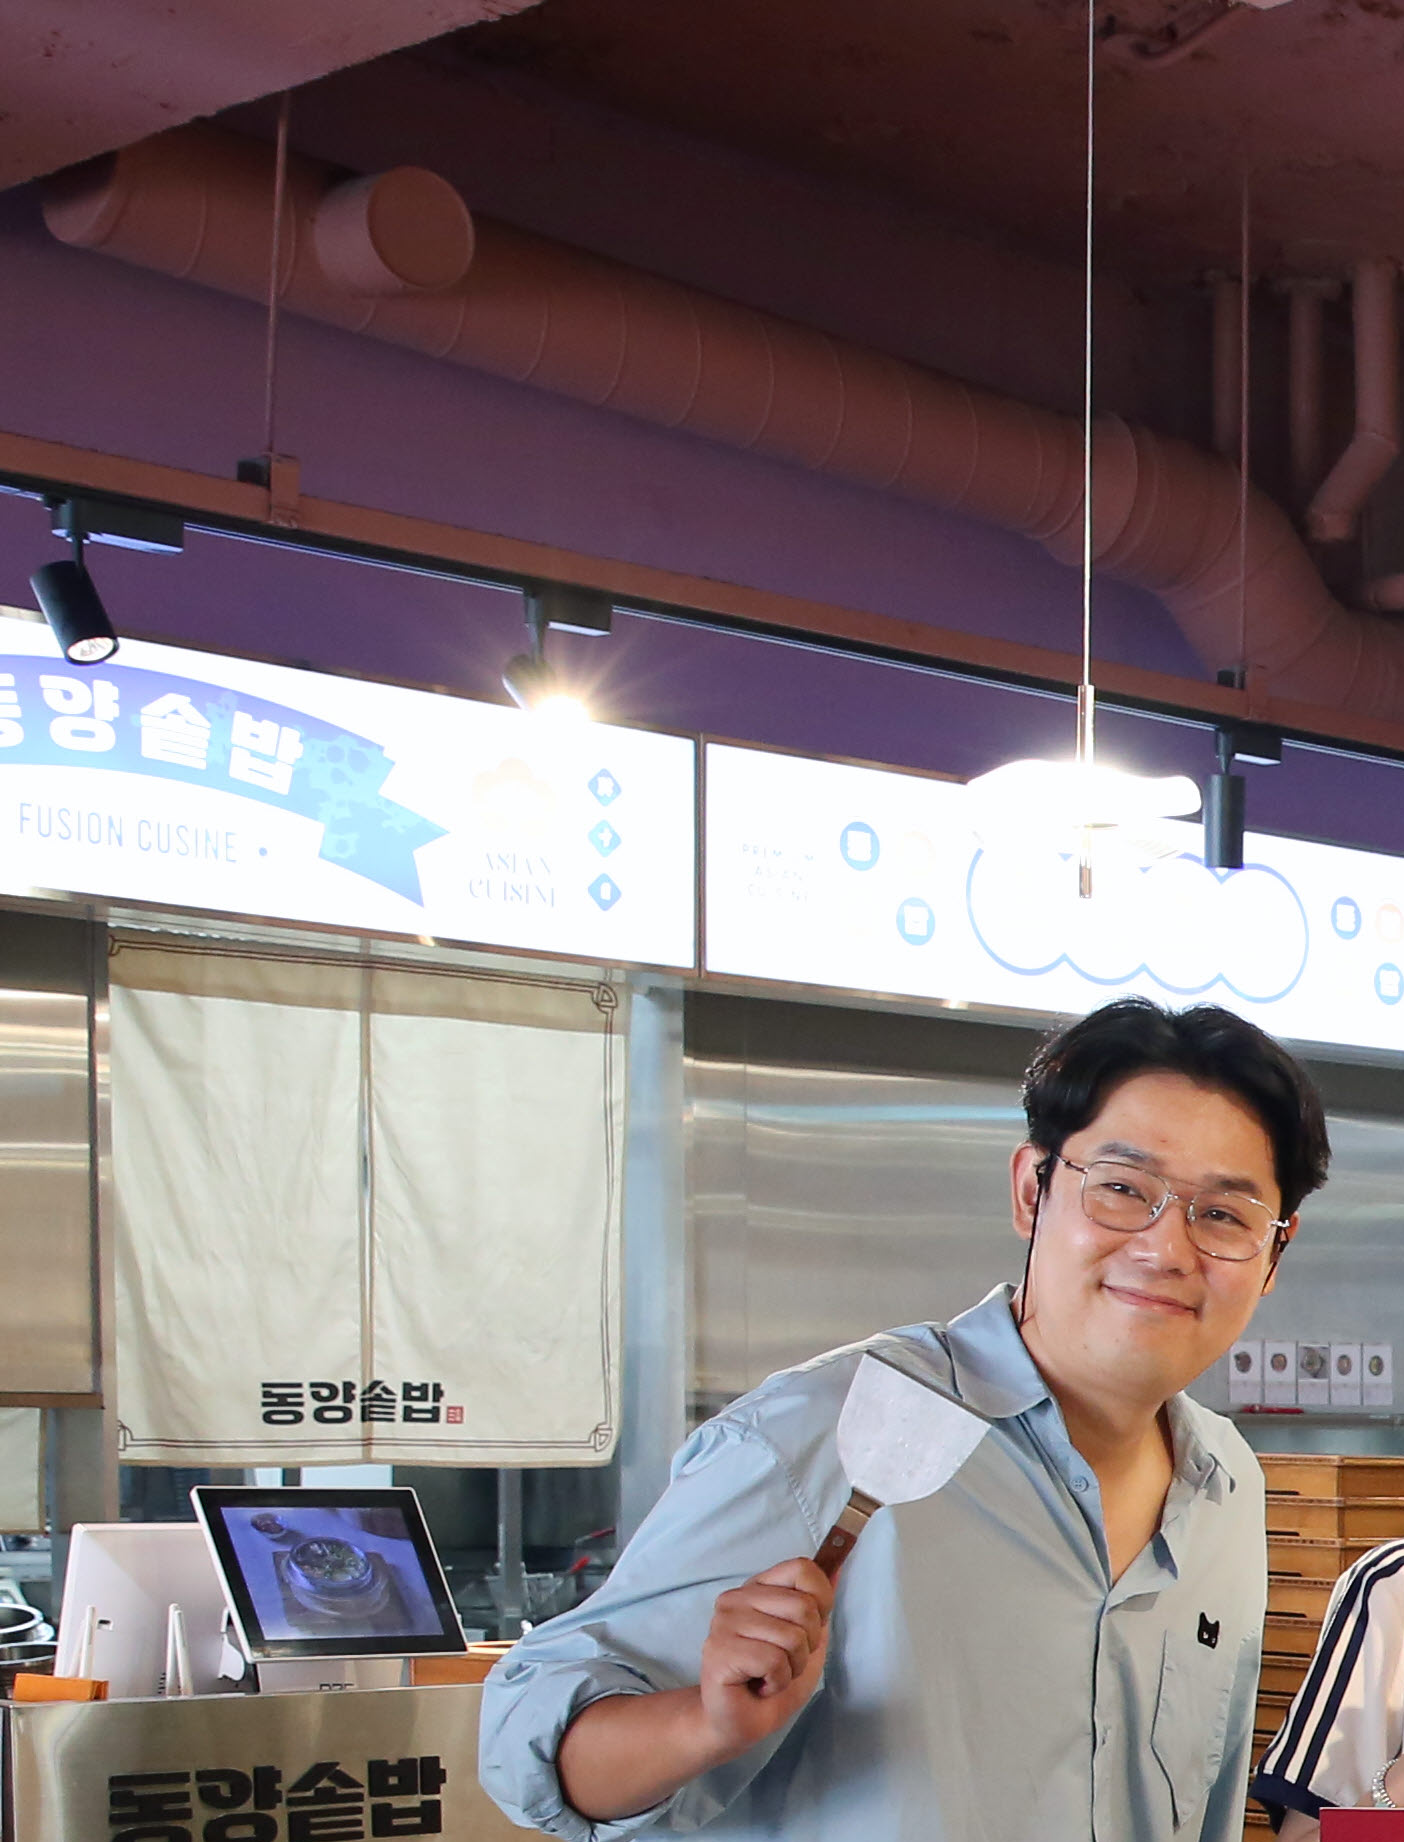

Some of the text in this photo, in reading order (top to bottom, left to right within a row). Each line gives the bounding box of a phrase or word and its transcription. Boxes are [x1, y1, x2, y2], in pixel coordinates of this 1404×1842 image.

[19, 802, 238, 864] FUSION CUSINE
[261, 1380, 444, 1425] 동양솥밥
